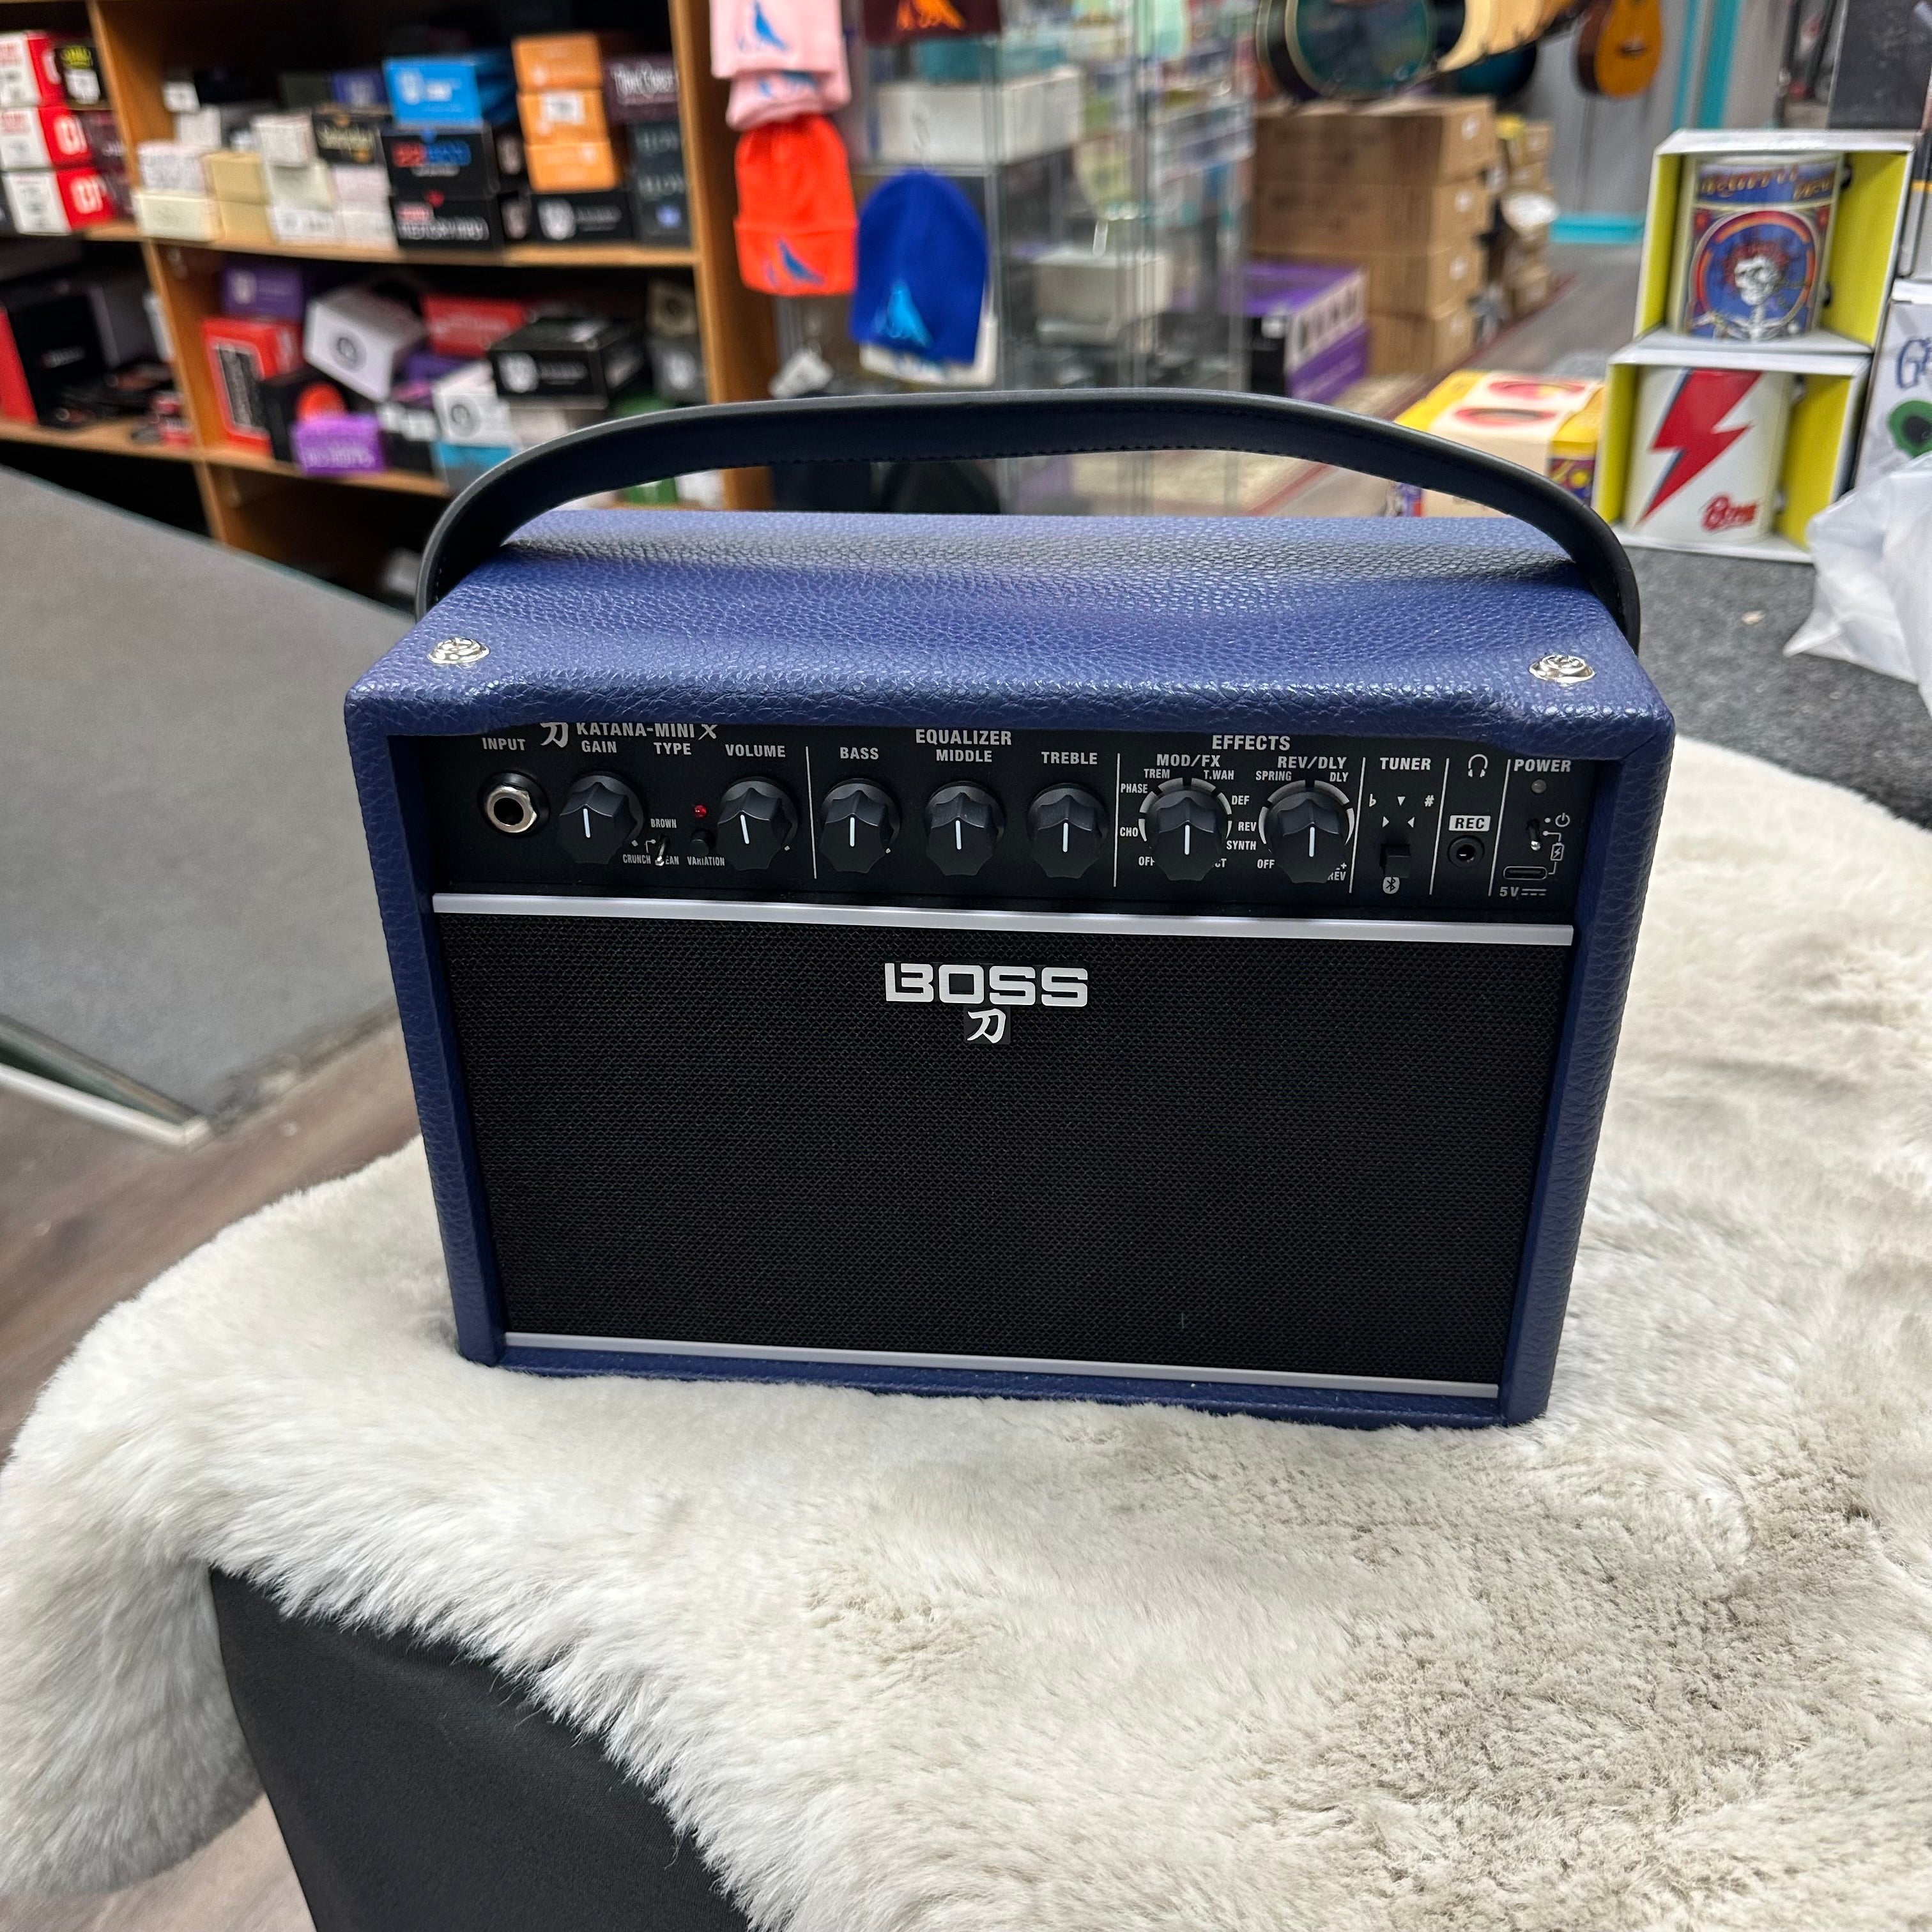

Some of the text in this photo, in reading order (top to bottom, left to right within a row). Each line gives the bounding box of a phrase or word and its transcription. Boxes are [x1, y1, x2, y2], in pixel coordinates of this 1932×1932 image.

[540, 721, 569, 748] 刀
[576, 722, 717, 740] KATANA-MINI X
[916, 728, 1012, 746] EQUALIZER
[482, 737, 526, 751] INPUT
[581, 740, 617, 753] GAIN
[653, 742, 692, 755] TYPE
[1212, 735, 1291, 751] EFFECTS
[724, 744, 786, 758] VOLUME
[839, 747, 879, 760] BASS
[936, 749, 992, 763] MIDDLE
[1041, 751, 1098, 765] TREBLE
[1156, 753, 1221, 767] MOD/FX
[1277, 756, 1347, 769] REV/DLY
[1379, 757, 1431, 770] TUNER
[1514, 758, 1571, 772] POWER
[1143, 768, 1170, 779] TREM
[1203, 769, 1234, 781] T.WAH
[1255, 770, 1292, 781] SPRING
[1330, 772, 1349, 783] DLY
[1121, 783, 1148, 794] PHASE
[1231, 795, 1250, 806] DEF
[650, 818, 677, 829] BROWN
[1238, 821, 1257, 832] REV
[1455, 817, 1485, 829] REC
[1119, 826, 1138, 838] CHO
[1226, 840, 1257, 851] SYNTH
[622, 853, 651, 864] CRUNCH
[687, 856, 725, 866] VARIATION
[1257, 859, 1275, 869] OFF
[1499, 886, 1519, 897] 5V
[884, 962, 1088, 1008] BOSS
[967, 1008, 1006, 1044] 刀
